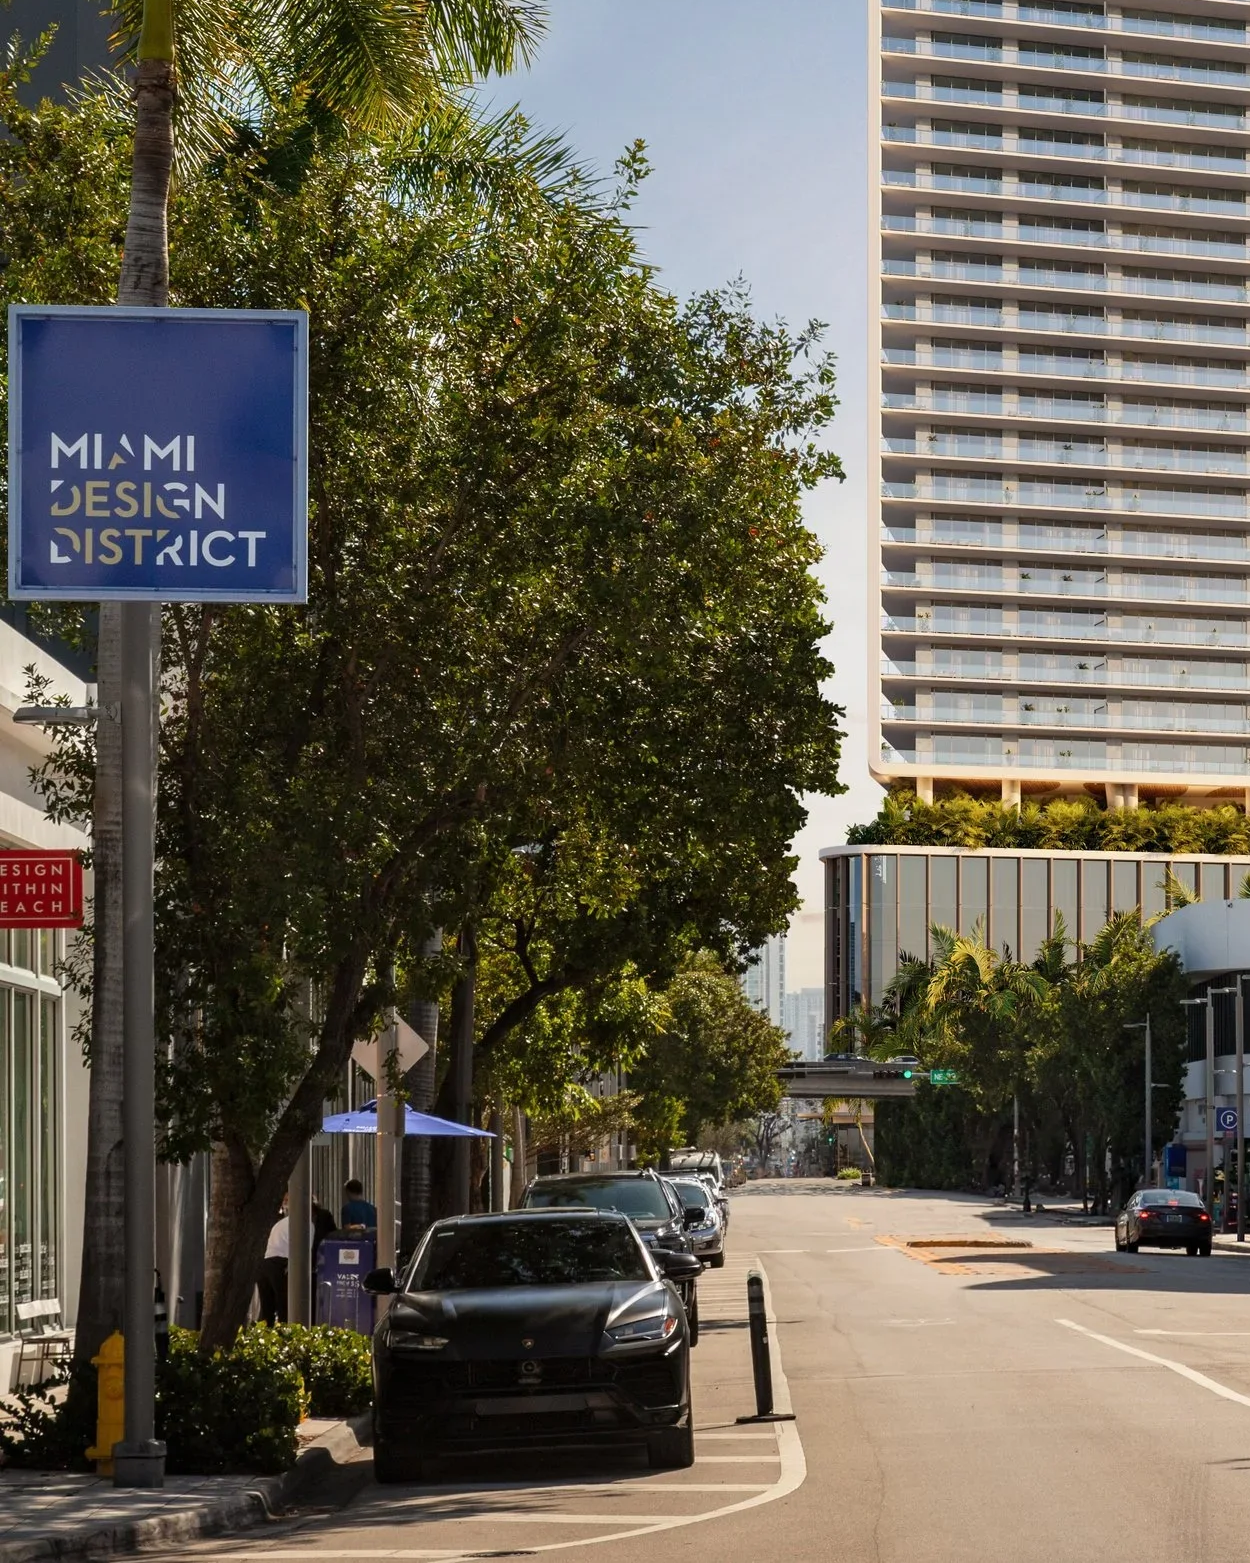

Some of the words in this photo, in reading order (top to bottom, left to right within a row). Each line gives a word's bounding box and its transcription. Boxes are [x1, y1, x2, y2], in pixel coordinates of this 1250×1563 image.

[50, 432, 195, 472] MIAMI
[50, 480, 225, 520] DESIGN
[50, 528, 267, 567] DISTRICT
[0, 864, 63, 876] ESIGN
[3, 883, 63, 895] ITHIN
[0, 901, 63, 913] EACH
